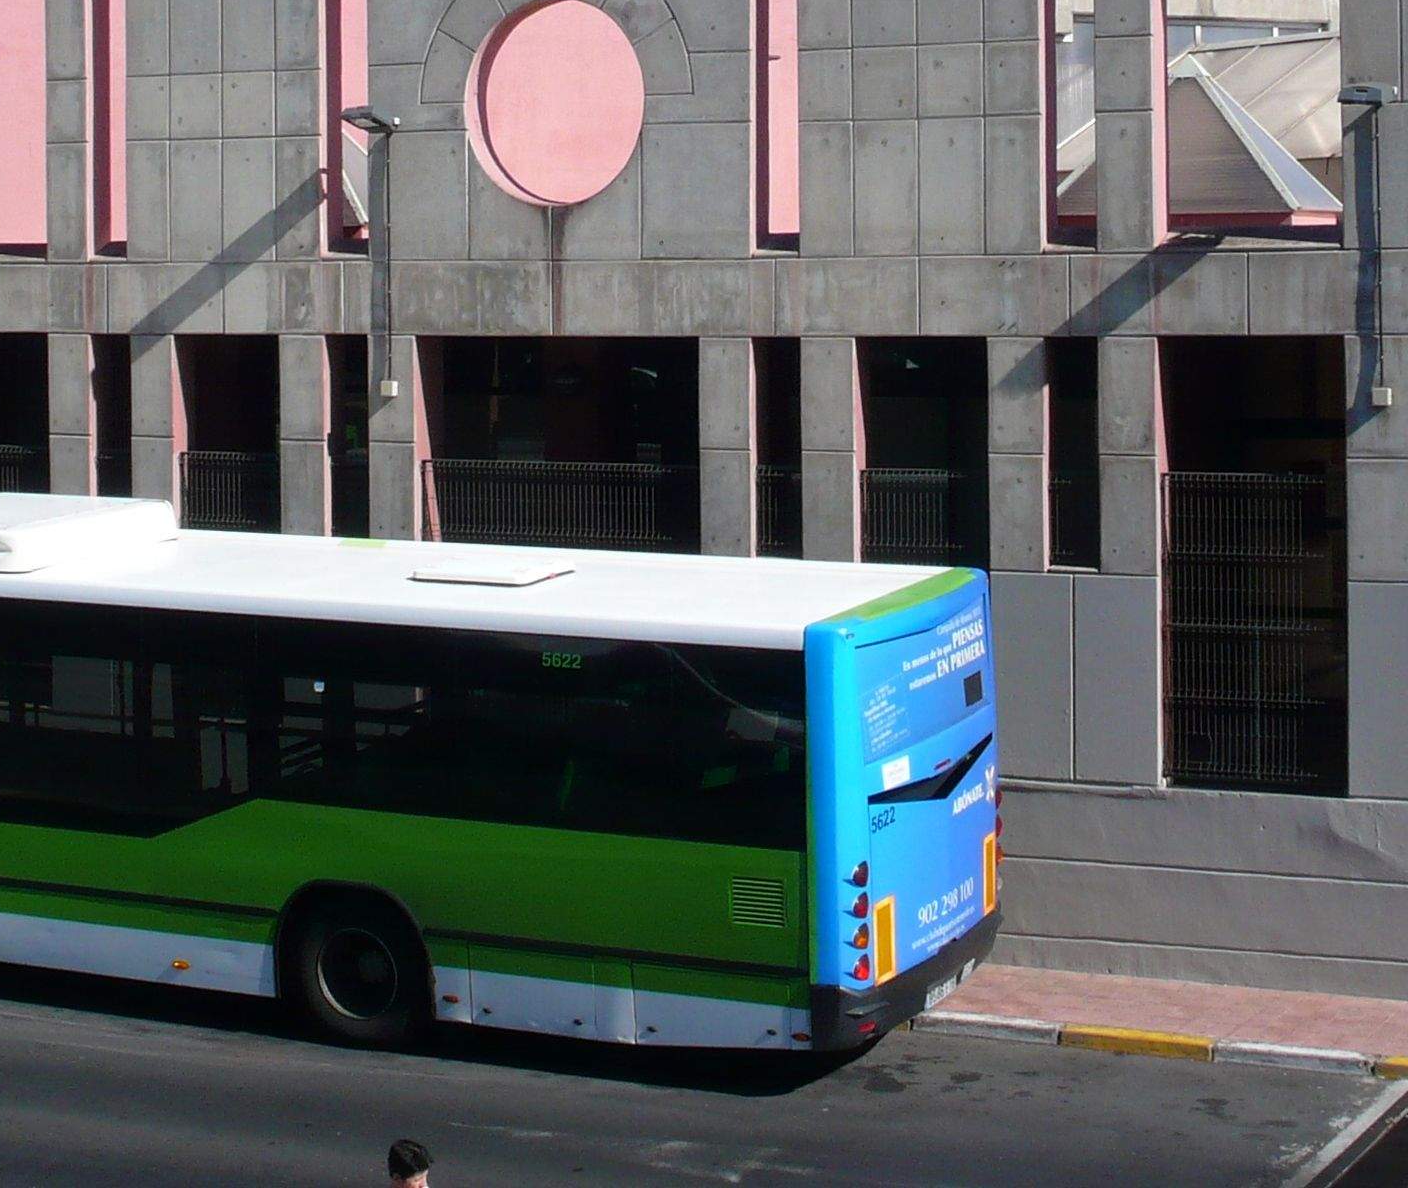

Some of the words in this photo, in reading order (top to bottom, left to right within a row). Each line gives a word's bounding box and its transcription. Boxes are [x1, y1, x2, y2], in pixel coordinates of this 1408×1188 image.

[953, 619, 983, 649] PIENSAS
[542, 651, 581, 669] 5622
[937, 656, 950, 678] EN
[950, 640, 985, 671] PRIMERA
[872, 806, 896, 834] 5622
[918, 900, 938, 928] 902
[941, 888, 958, 916] 298
[960, 877, 974, 903] 100
